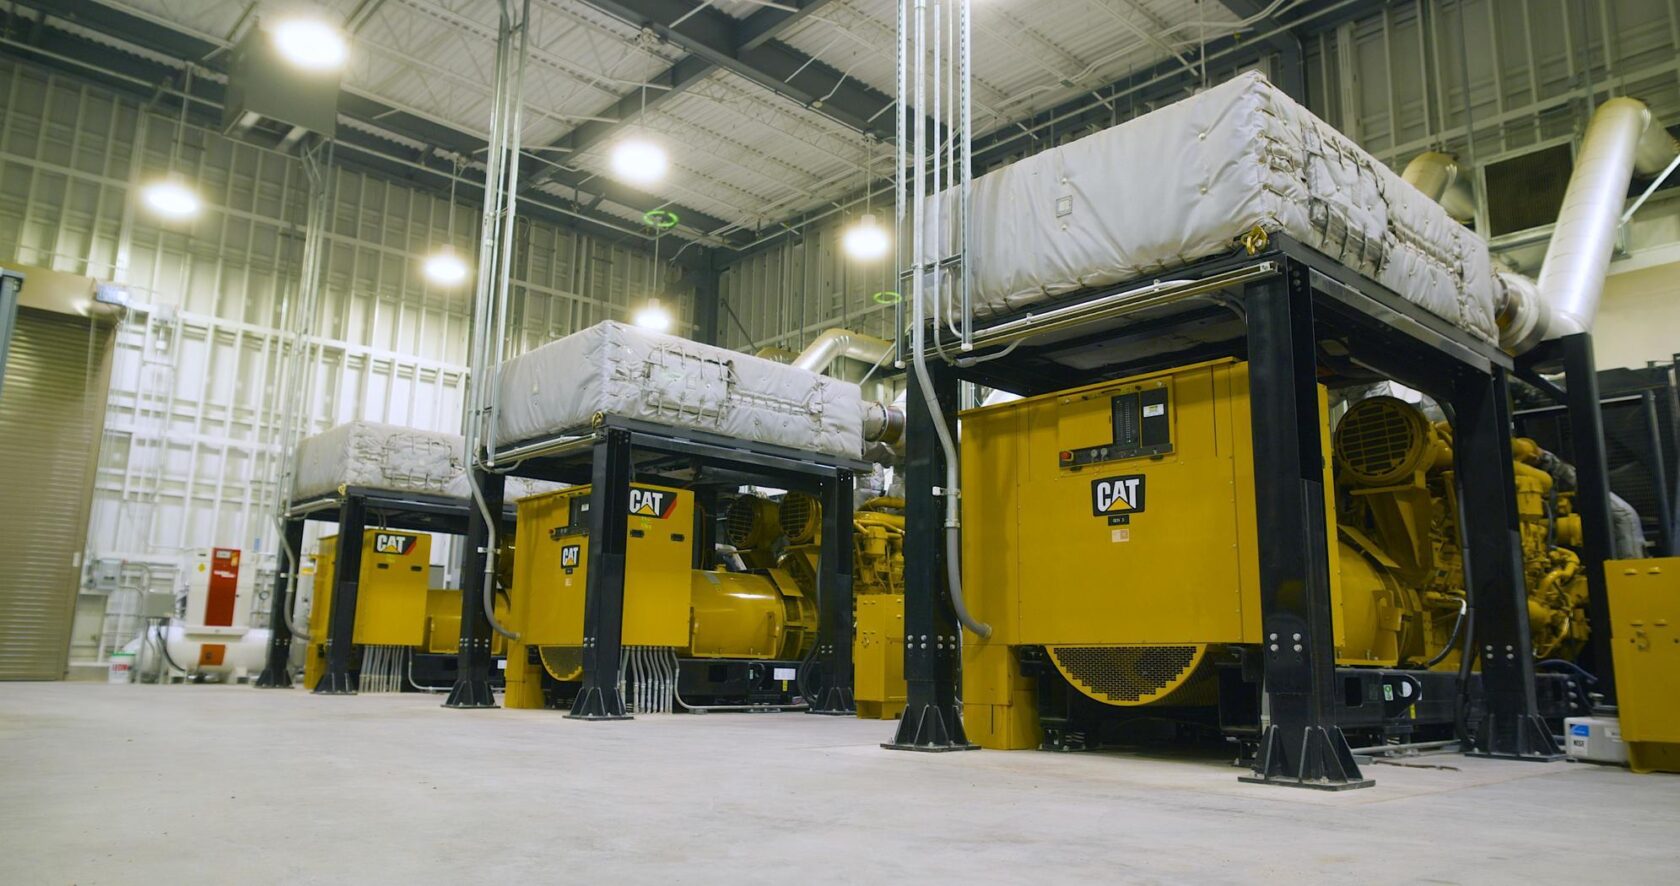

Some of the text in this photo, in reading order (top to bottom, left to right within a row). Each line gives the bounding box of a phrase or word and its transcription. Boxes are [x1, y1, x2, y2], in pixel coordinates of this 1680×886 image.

[629, 489, 663, 517] CAT
[1097, 479, 1139, 512] CAT
[376, 534, 406, 553] CAT
[562, 546, 579, 567] CAT
